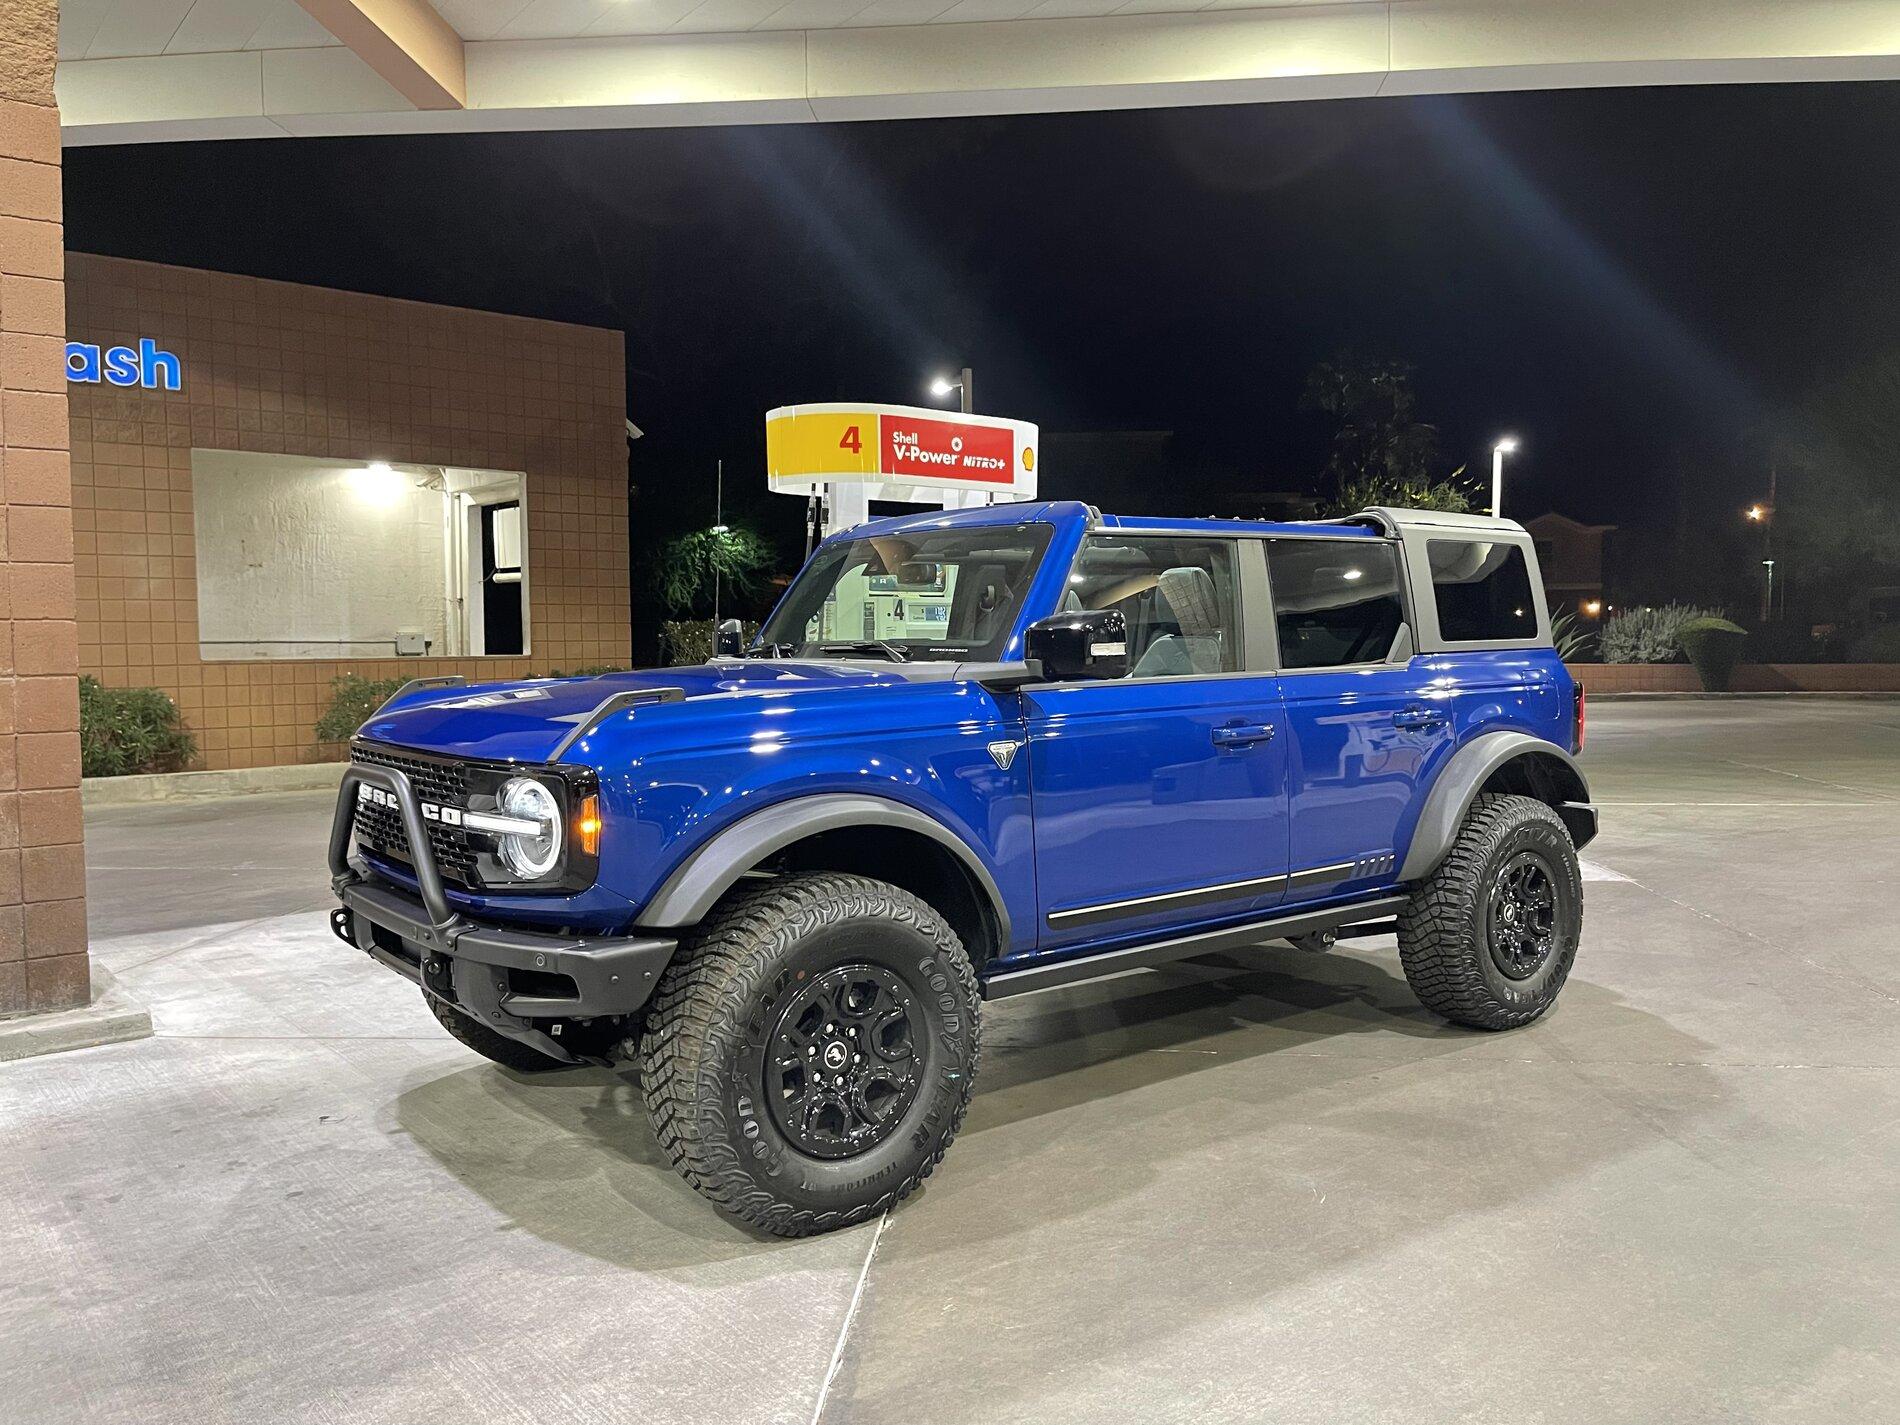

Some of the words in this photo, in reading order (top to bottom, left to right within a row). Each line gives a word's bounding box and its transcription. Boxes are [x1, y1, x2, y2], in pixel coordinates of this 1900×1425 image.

[839, 426, 862, 454] 4
[893, 431, 918, 445] Shell
[893, 444, 958, 465] V-Power
[894, 599, 904, 620] 4
[358, 782, 461, 826] BROCO
